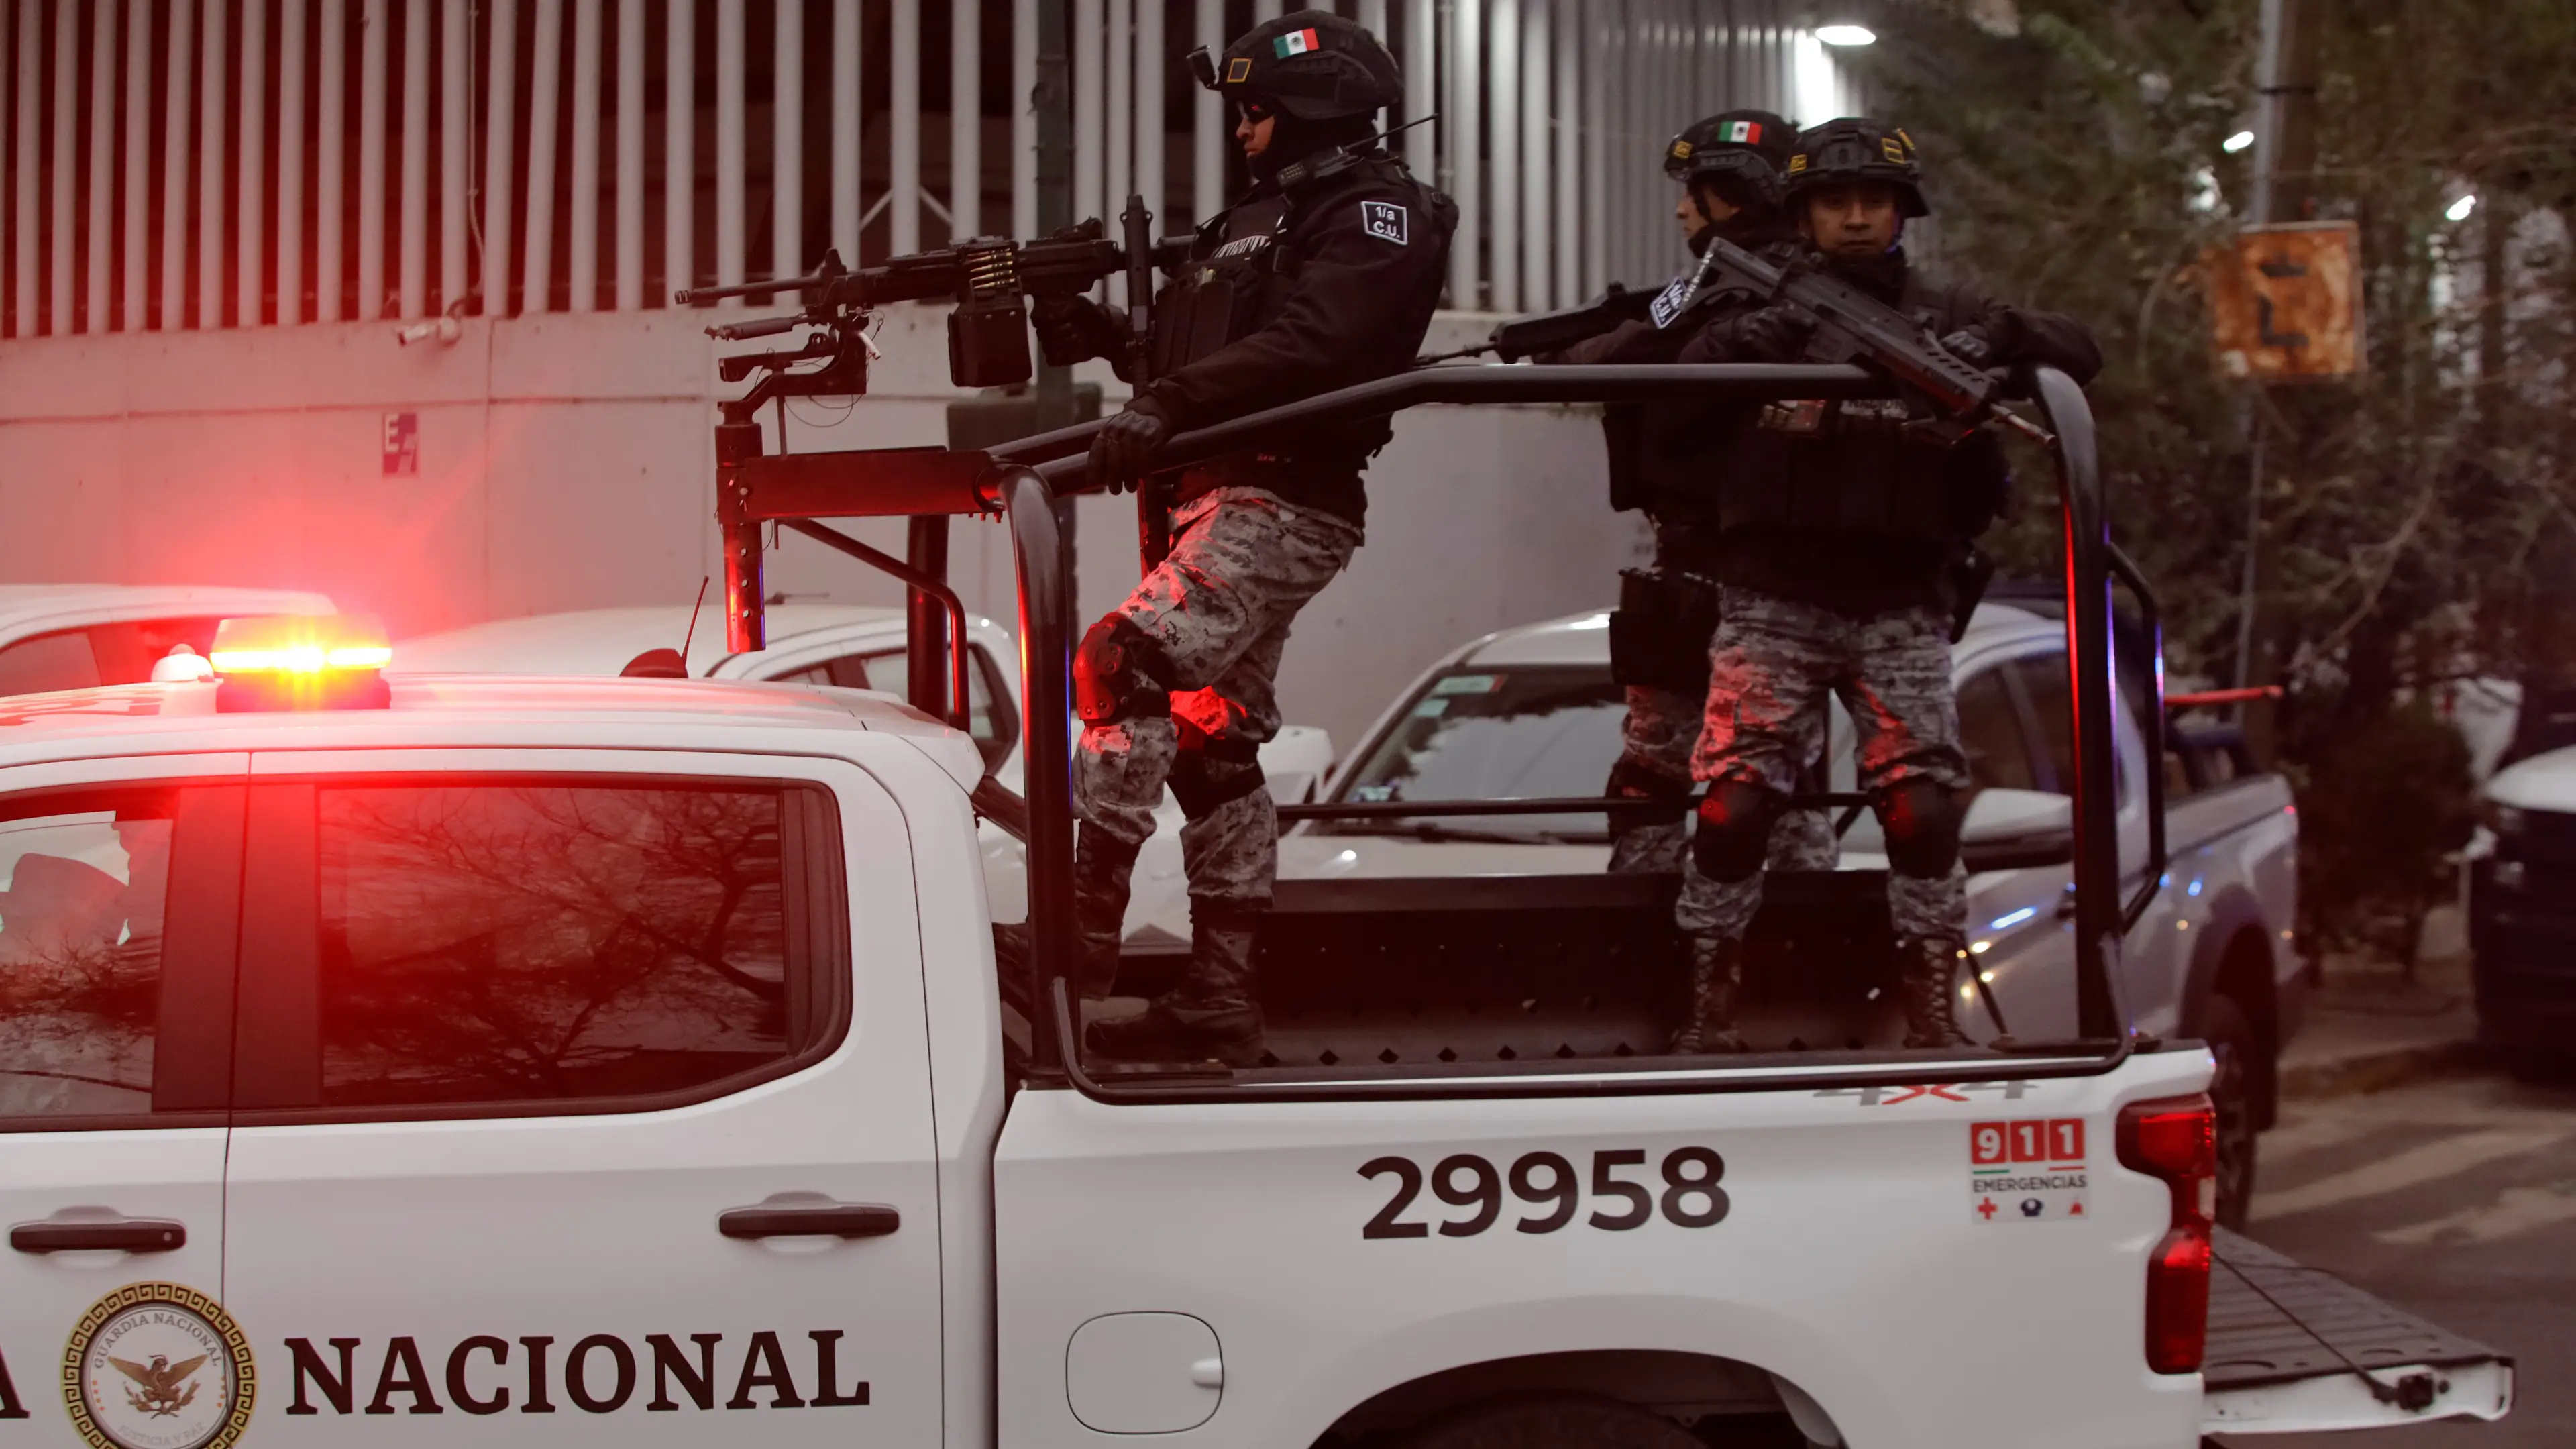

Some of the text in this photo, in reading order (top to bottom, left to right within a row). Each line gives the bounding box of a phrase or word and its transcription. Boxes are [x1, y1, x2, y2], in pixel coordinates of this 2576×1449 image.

[1373, 221, 1401, 239] C.U.
[1977, 1124, 2074, 1160] 911
[1356, 1146, 1729, 1240] 29958
[1973, 1175, 2088, 1193] EMERGENCIAS
[94, 1312, 223, 1369] GUARDIA NACIONAL
[284, 1330, 870, 1415] NACIONAL
